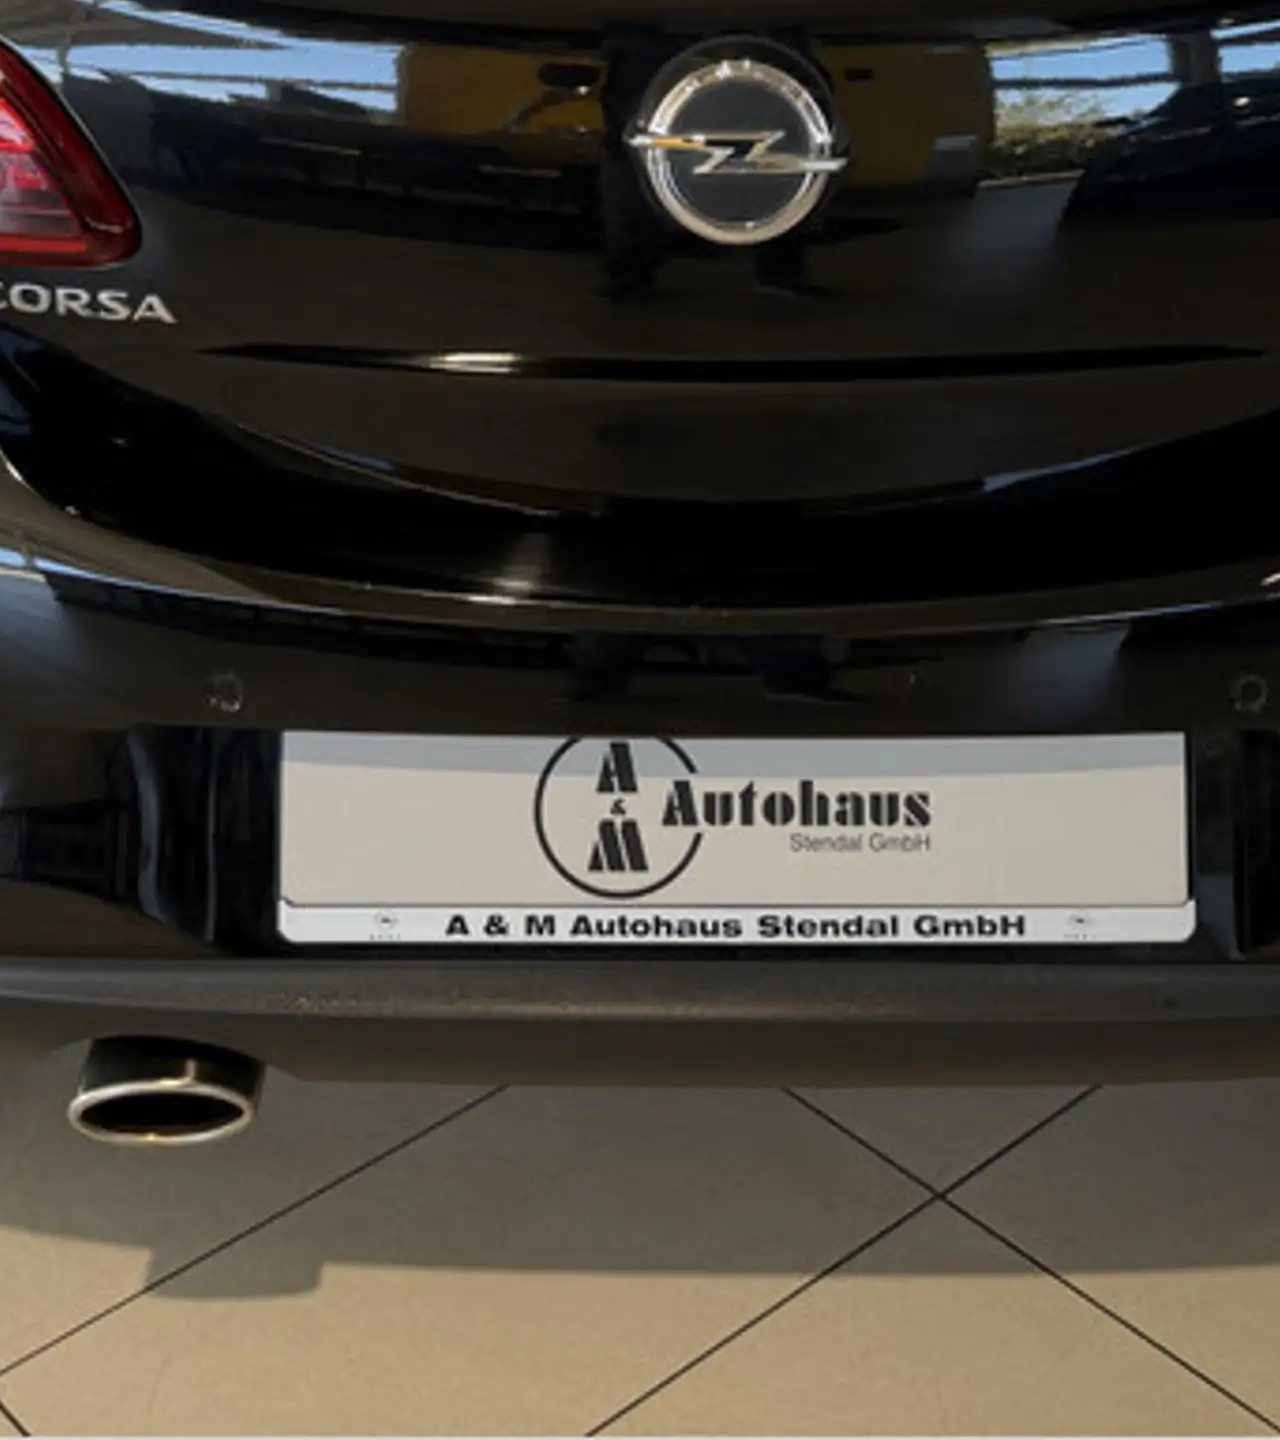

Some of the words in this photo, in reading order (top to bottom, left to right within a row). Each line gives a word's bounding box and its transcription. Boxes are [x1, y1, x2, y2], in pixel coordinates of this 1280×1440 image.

[596, 742, 638, 792] A
[610, 799, 626, 815] &
[662, 780, 931, 826] Autohaus
[588, 820, 649, 872] M
[790, 833, 862, 852] Stendal
[869, 832, 931, 852] GmbH
[446, 915, 469, 935] A
[484, 915, 508, 936] &
[526, 915, 555, 935] M
[570, 916, 742, 937] Autohaus
[758, 916, 898, 937] Stendal
[914, 915, 1024, 937] GmbH
